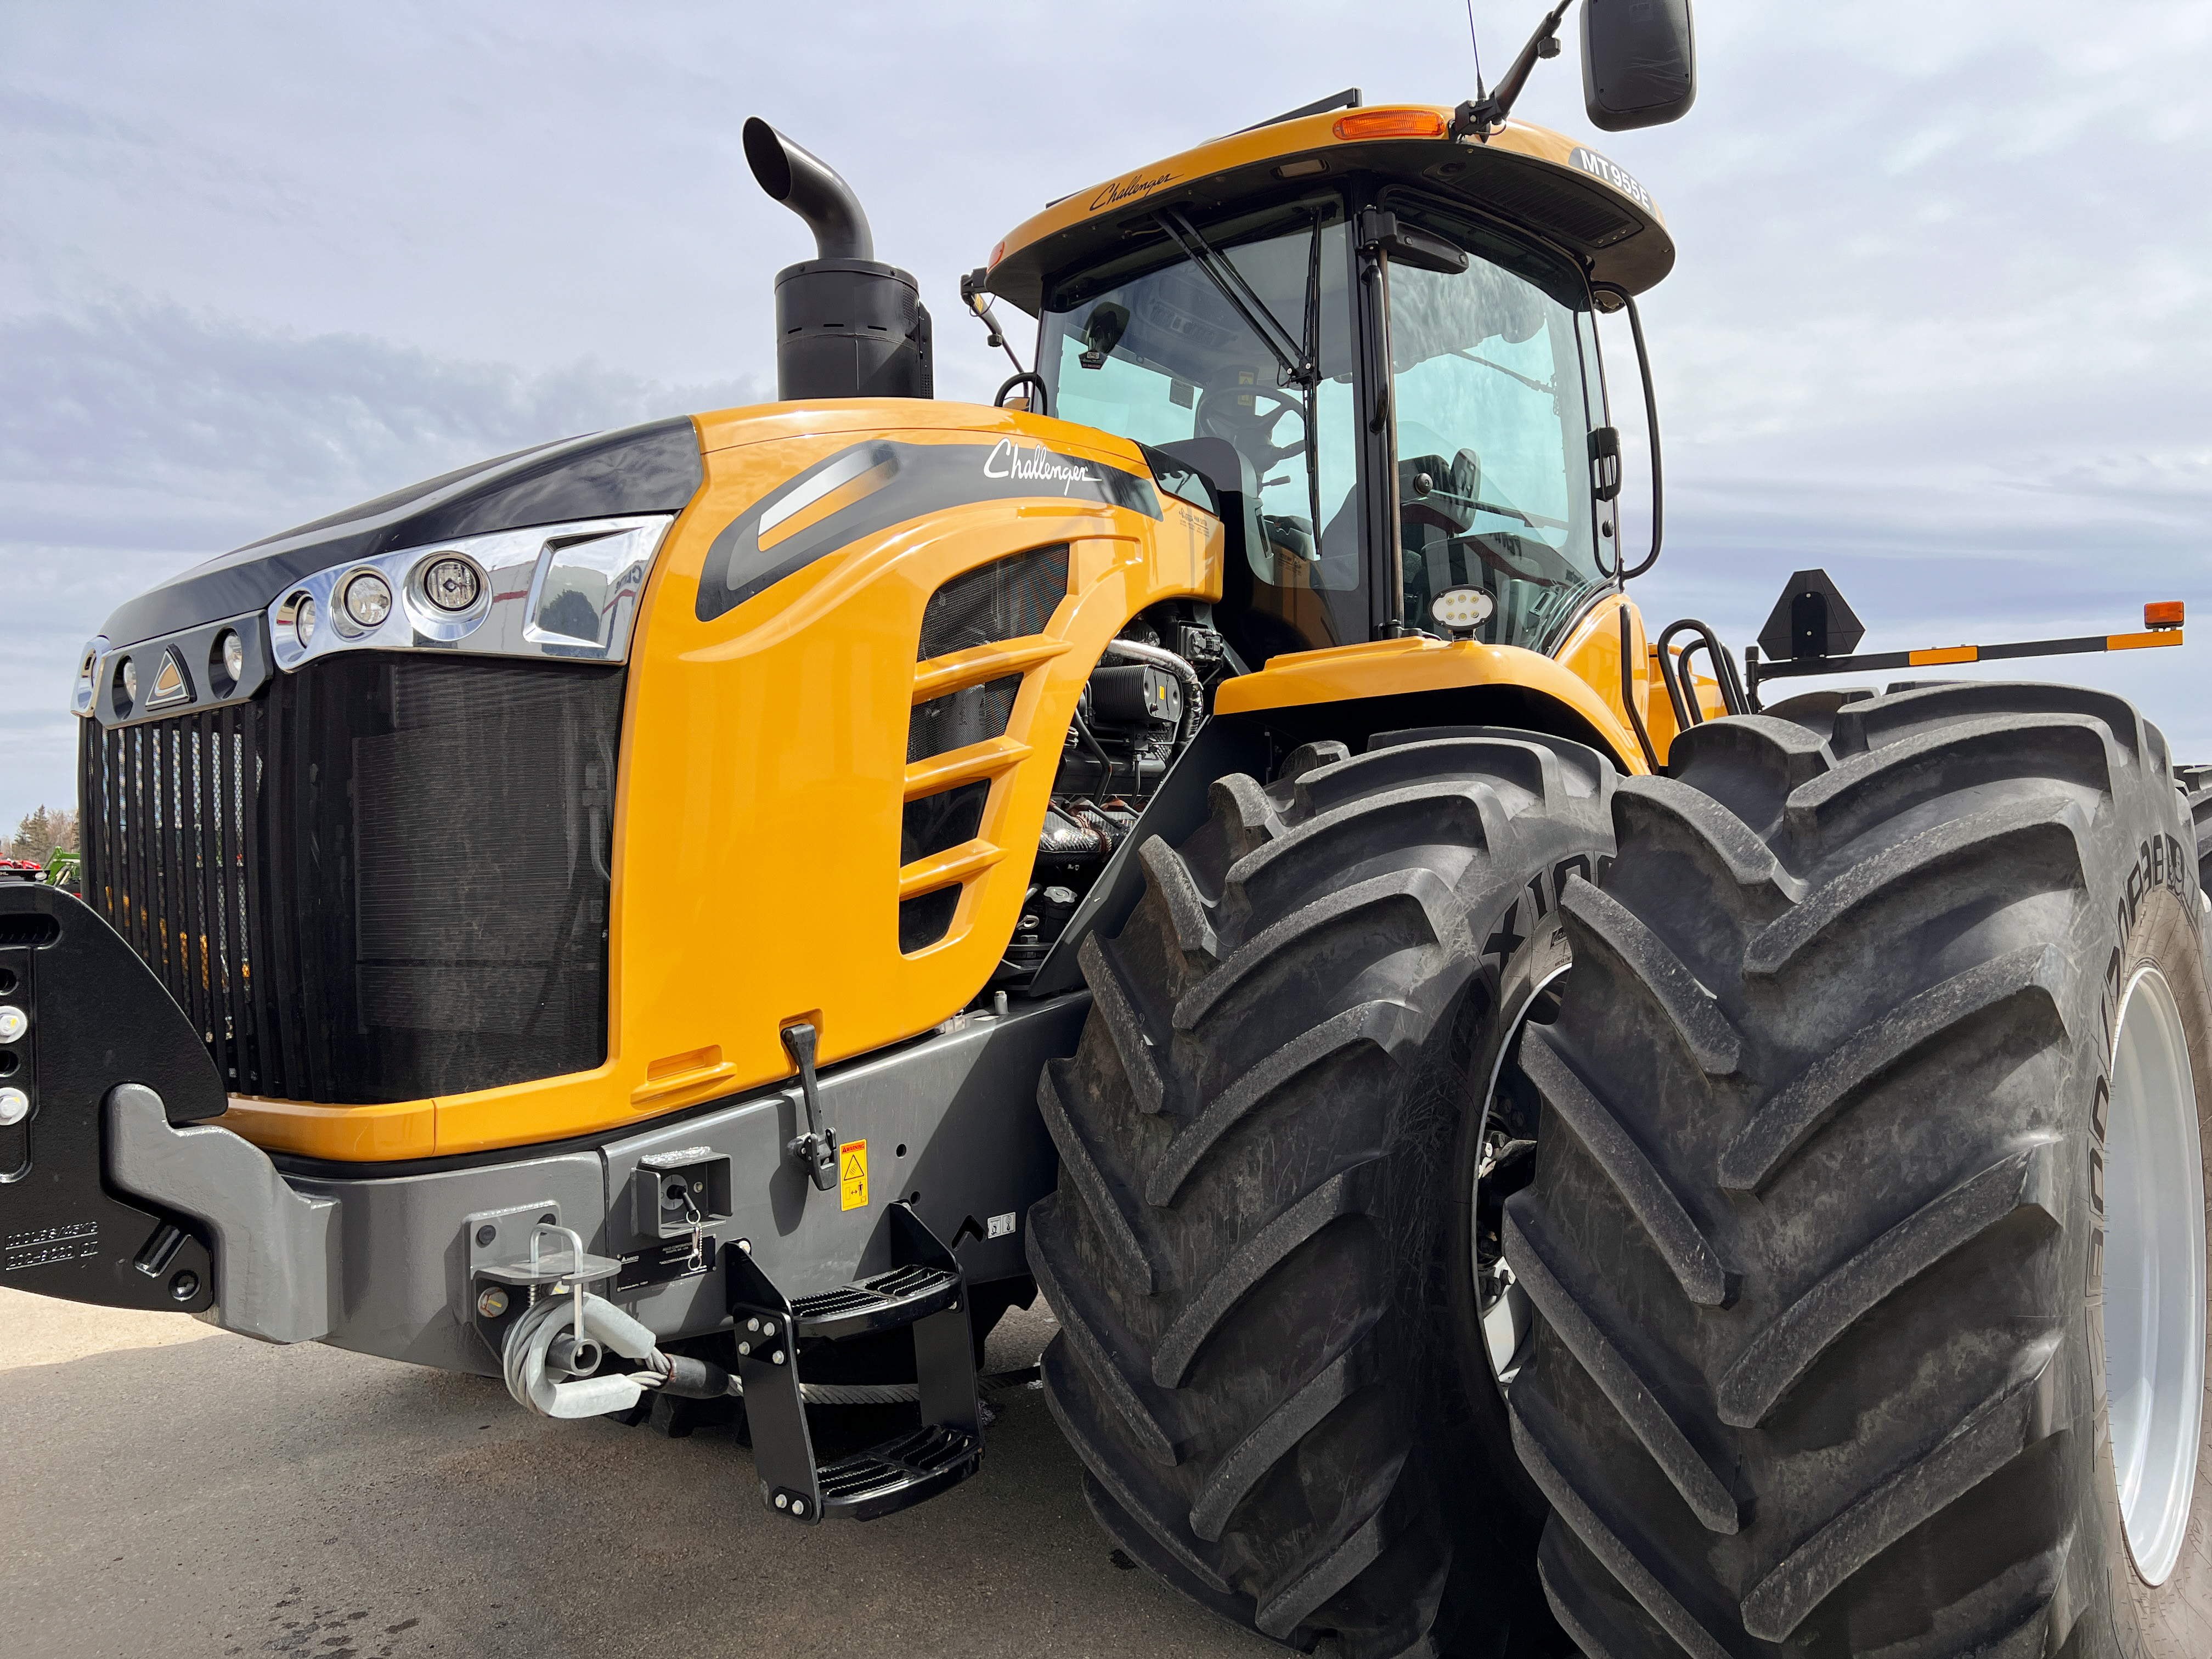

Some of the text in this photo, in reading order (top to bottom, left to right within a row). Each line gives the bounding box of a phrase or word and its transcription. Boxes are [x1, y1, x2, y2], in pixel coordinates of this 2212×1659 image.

[1090, 173, 1185, 211] Challenger
[1579, 148, 1651, 211] MT955E
[984, 438, 1103, 496] Challenger
